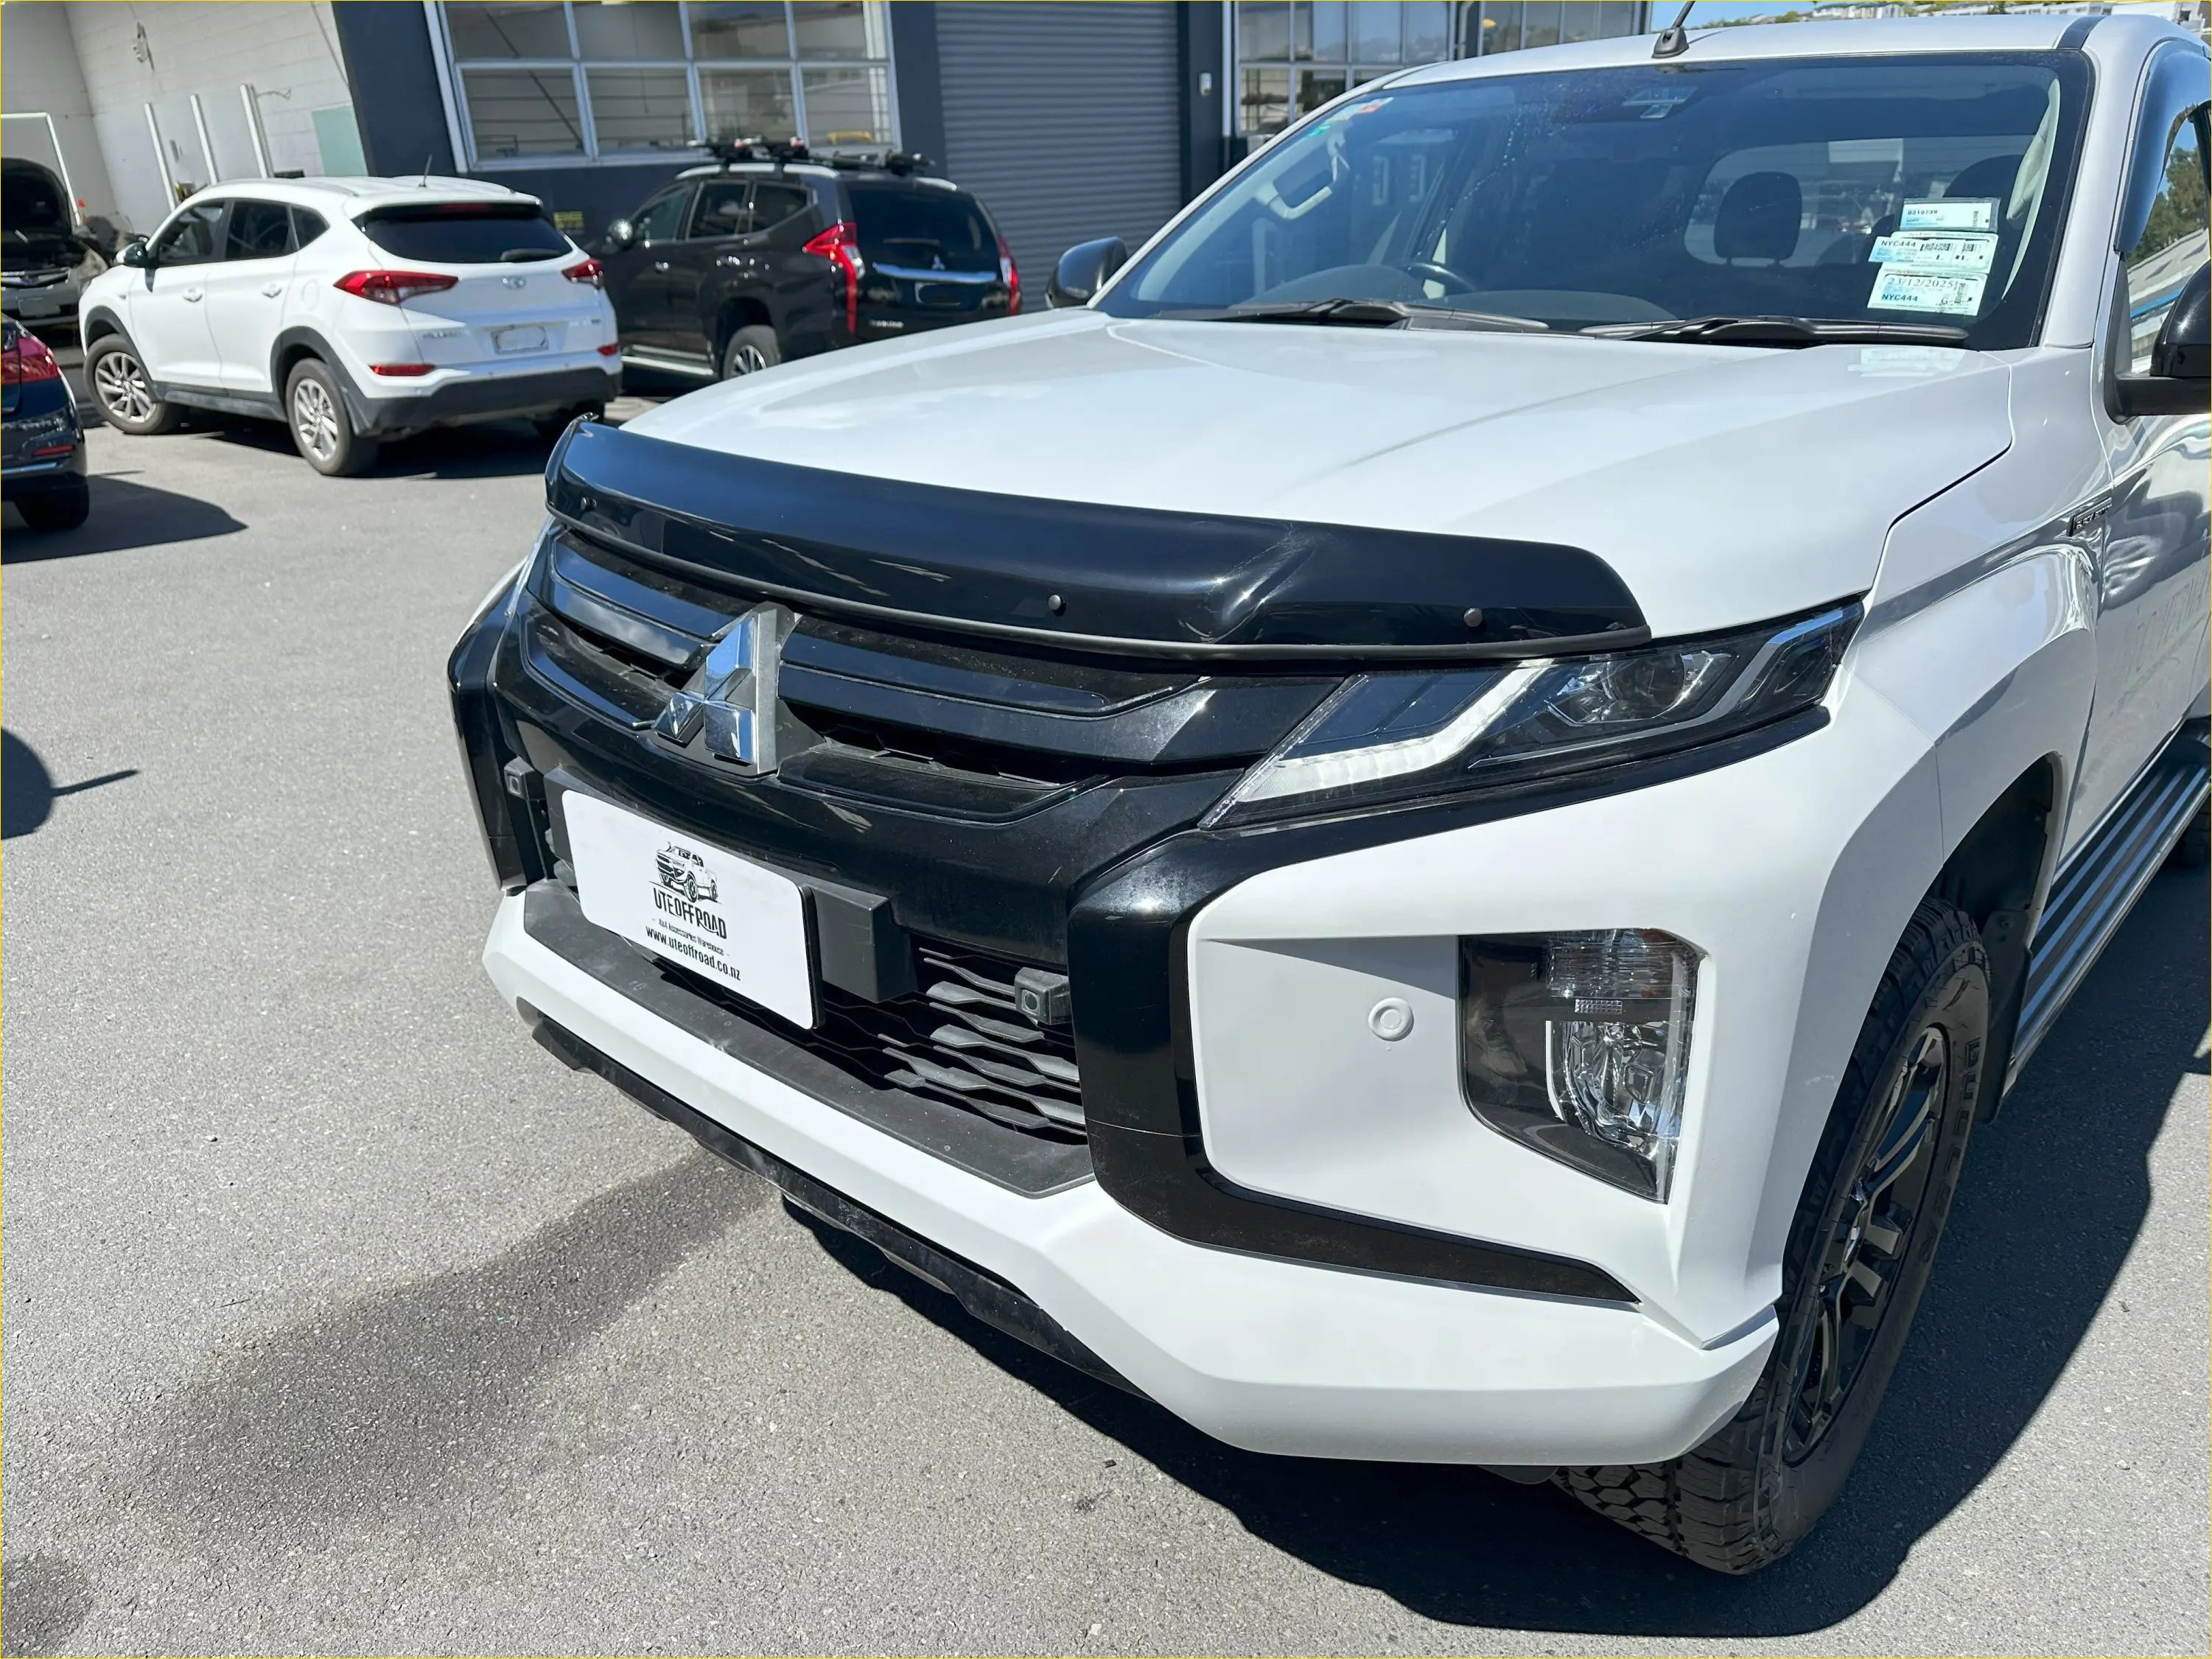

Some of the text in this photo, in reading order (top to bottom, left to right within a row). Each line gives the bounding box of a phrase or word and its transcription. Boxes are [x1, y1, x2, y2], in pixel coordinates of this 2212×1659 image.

[1881, 239, 1916, 248] NYC444
[1887, 277, 1953, 289] 23/12/2025
[1881, 293, 1918, 302] NYC444
[654, 887, 727, 939] UTEOFFROAD
[645, 925, 741, 981] www.uteoffroad.co.nz
